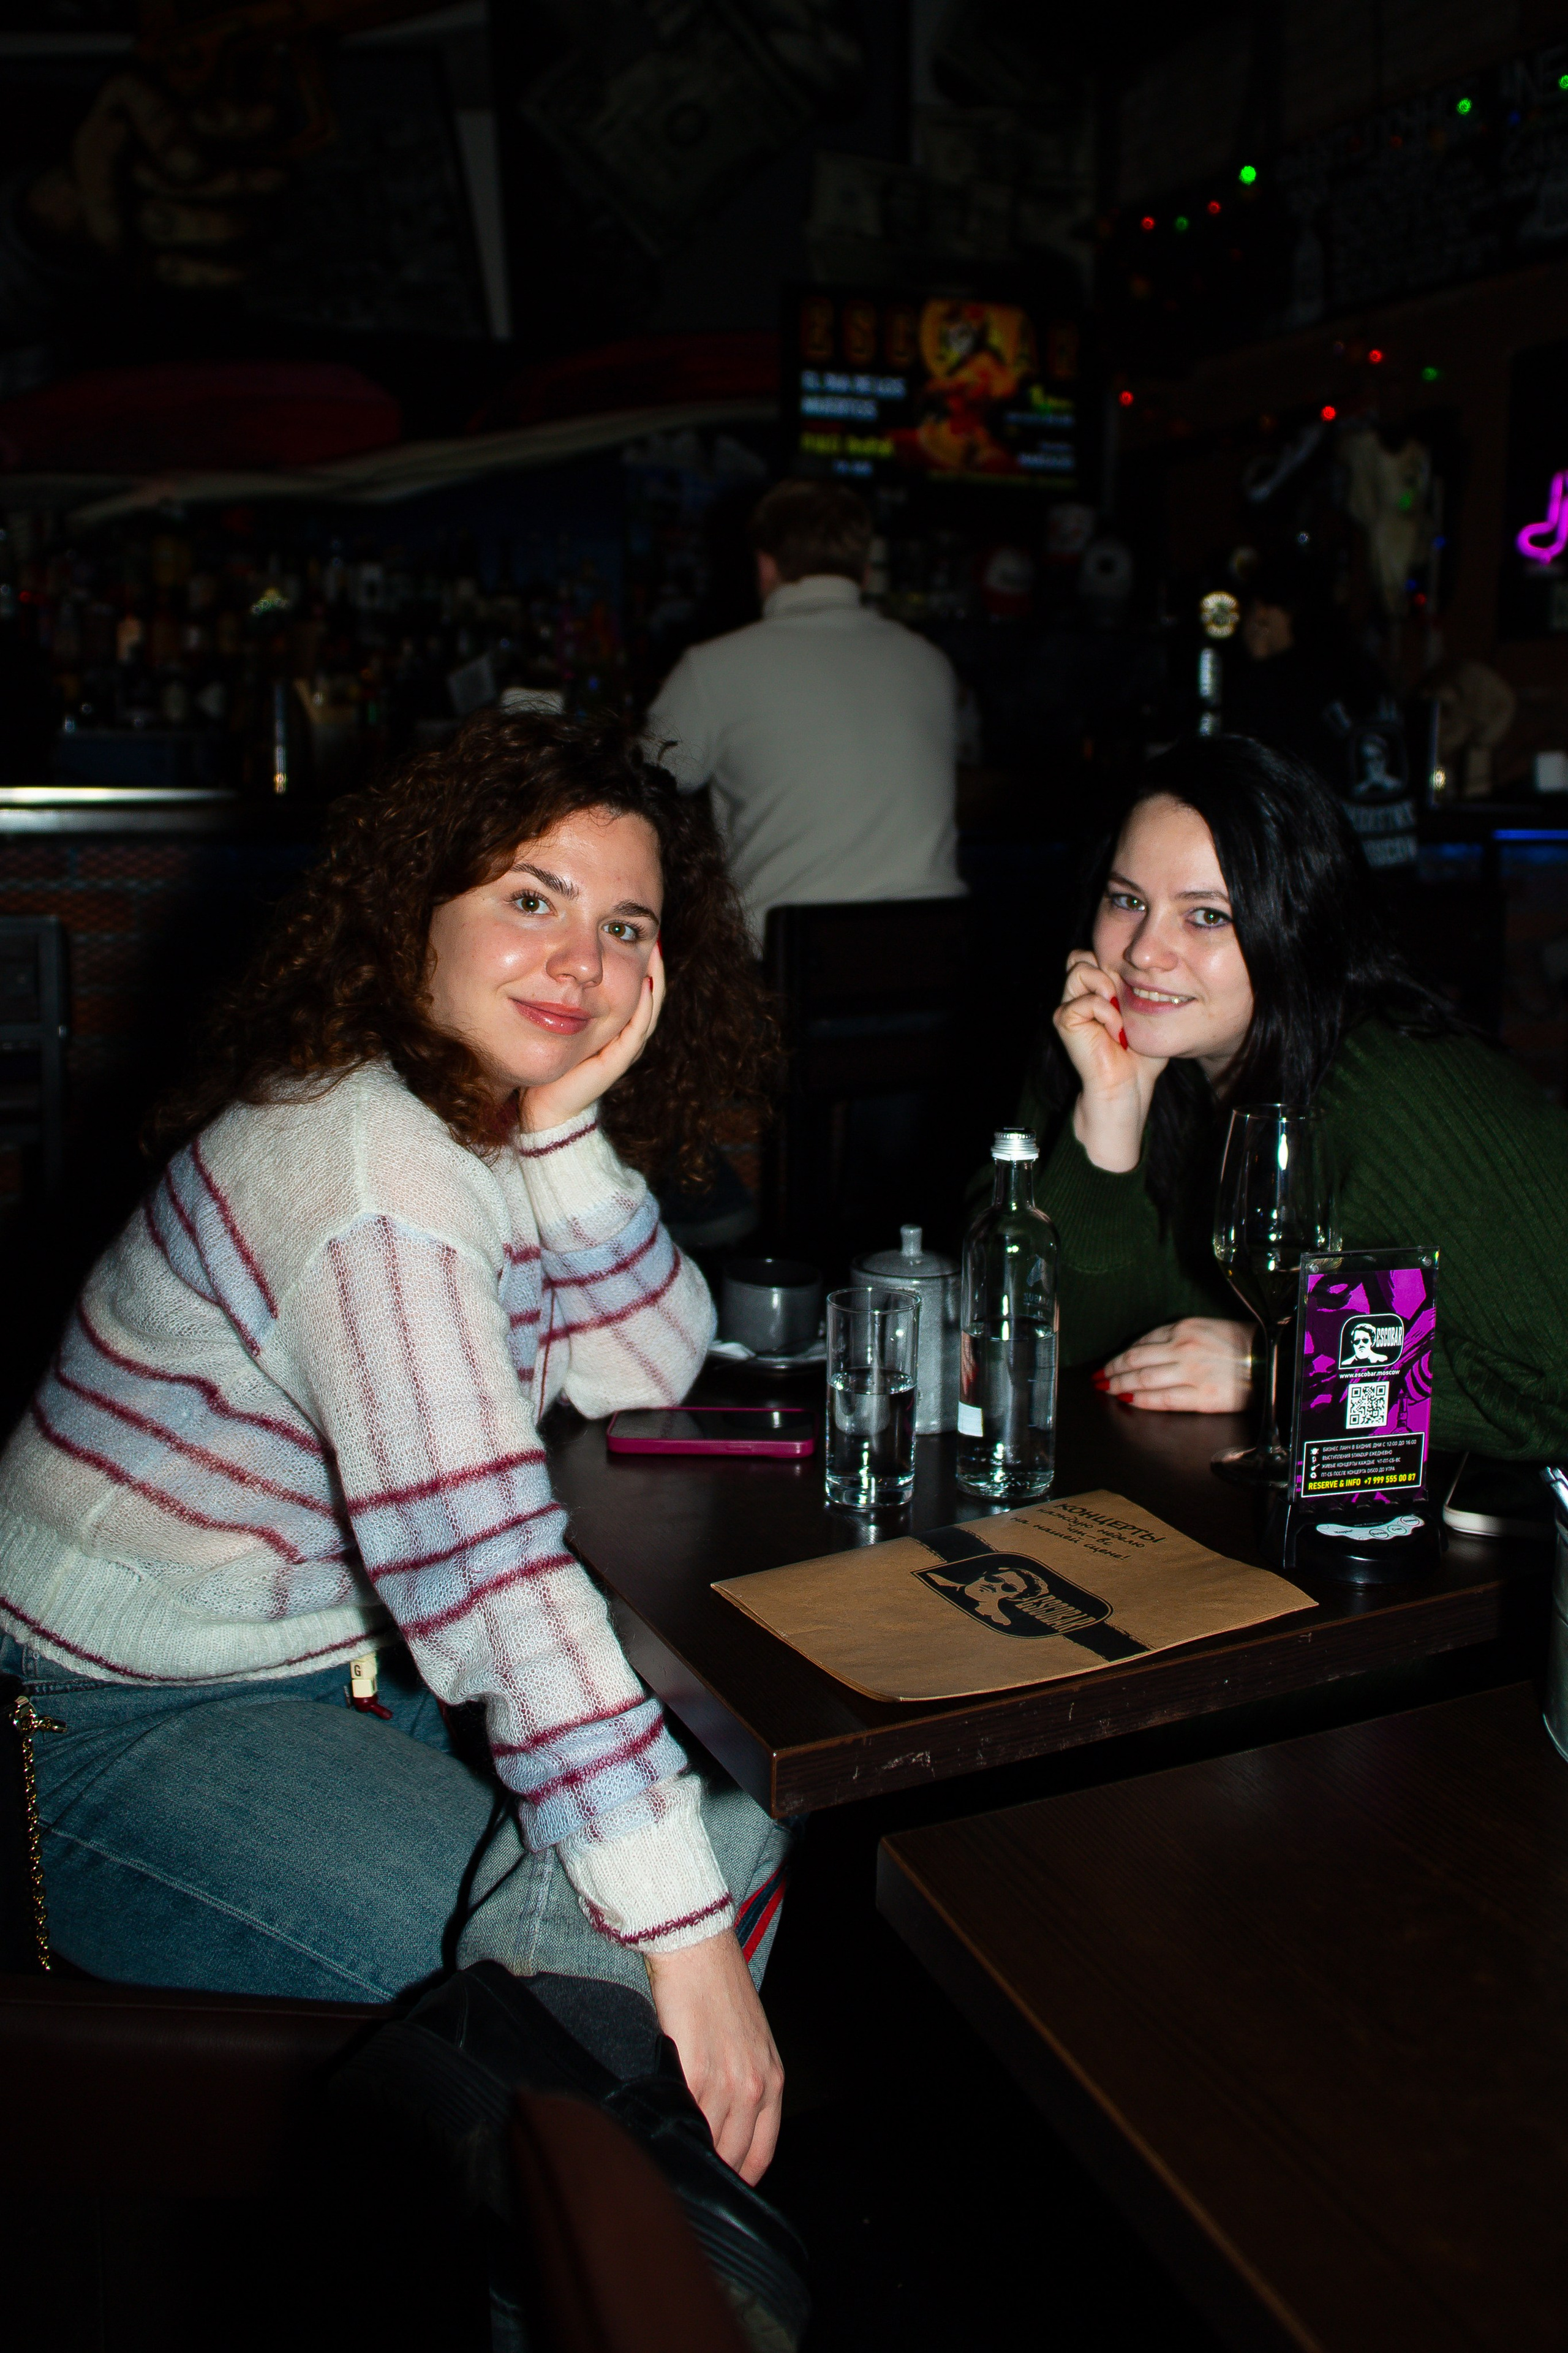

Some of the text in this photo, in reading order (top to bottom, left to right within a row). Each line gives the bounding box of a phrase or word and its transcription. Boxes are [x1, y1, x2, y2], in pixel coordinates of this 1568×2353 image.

[1376, 1326, 1403, 1347] ESCOBAR
[1339, 1370, 1400, 1379] www.escobar.moscow
[1308, 1480, 1338, 1490] RESERVE
[1345, 1478, 1361, 1487] INFO
[1385, 1475, 1398, 1483] 555
[1408, 1473, 1416, 1481] 87
[1036, 1508, 1145, 1548] каждую неделю
[1054, 1503, 1167, 1543] КОНЦЕРТЫ
[1033, 1524, 1081, 1544] нашей
[1084, 1543, 1131, 1561] сцене!
[1015, 1594, 1097, 1632] ESCOBAR
[354, 1664, 361, 1677] G
